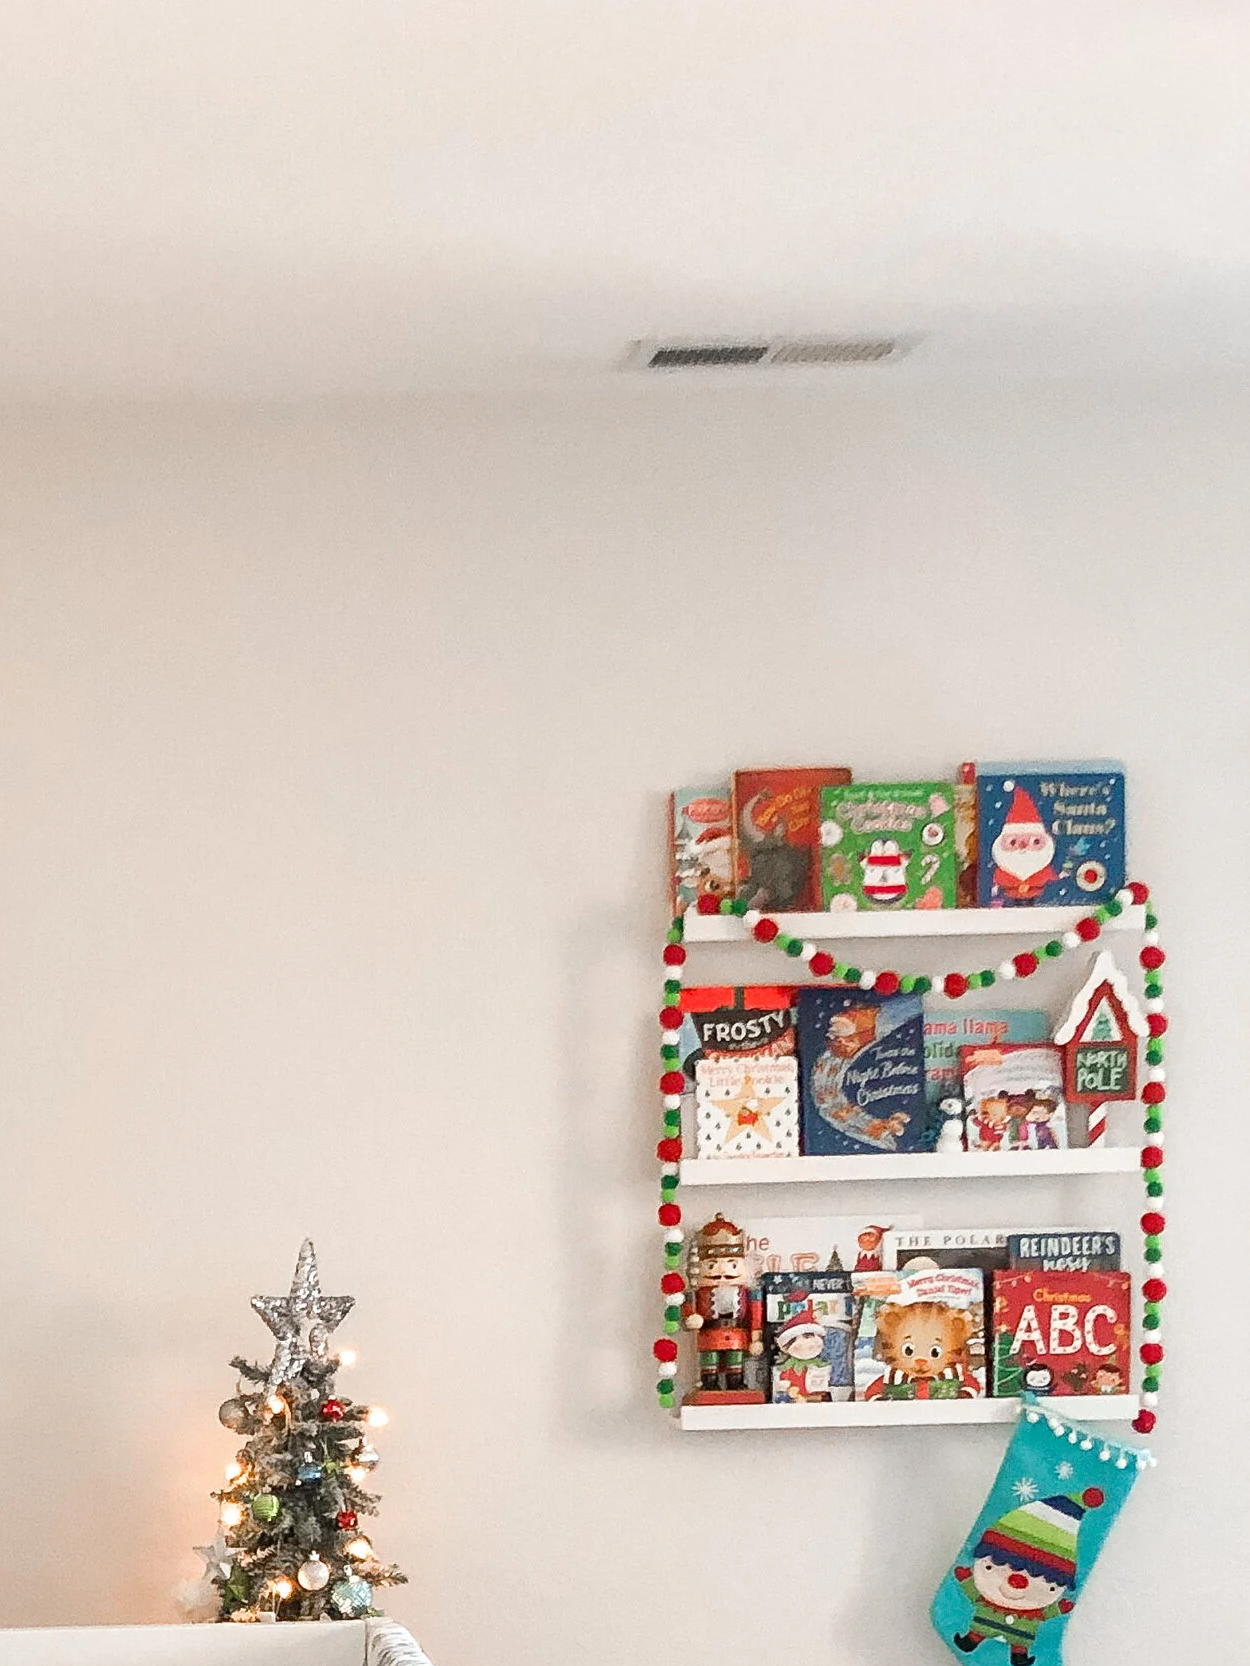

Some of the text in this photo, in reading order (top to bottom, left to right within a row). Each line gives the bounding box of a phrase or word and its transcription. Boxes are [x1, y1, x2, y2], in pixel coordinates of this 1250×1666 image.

[1040, 781, 1110, 797] Where's
[1053, 800, 1107, 816] Santa
[1052, 818, 1116, 835] Claus?
[703, 1010, 785, 1042] FROSTY
[963, 1018, 1008, 1035] llama
[1077, 1068, 1123, 1093] POLE
[857, 1083, 920, 1106] Christmas
[746, 1236, 770, 1251] he
[896, 1234, 1008, 1247] THE POLAR
[1019, 1235, 1116, 1258] REINDEER'S
[813, 1278, 844, 1291] NEVER
[907, 1276, 935, 1289] Merry
[1033, 1287, 1091, 1303] Christmas
[1010, 1304, 1118, 1355] ABC
